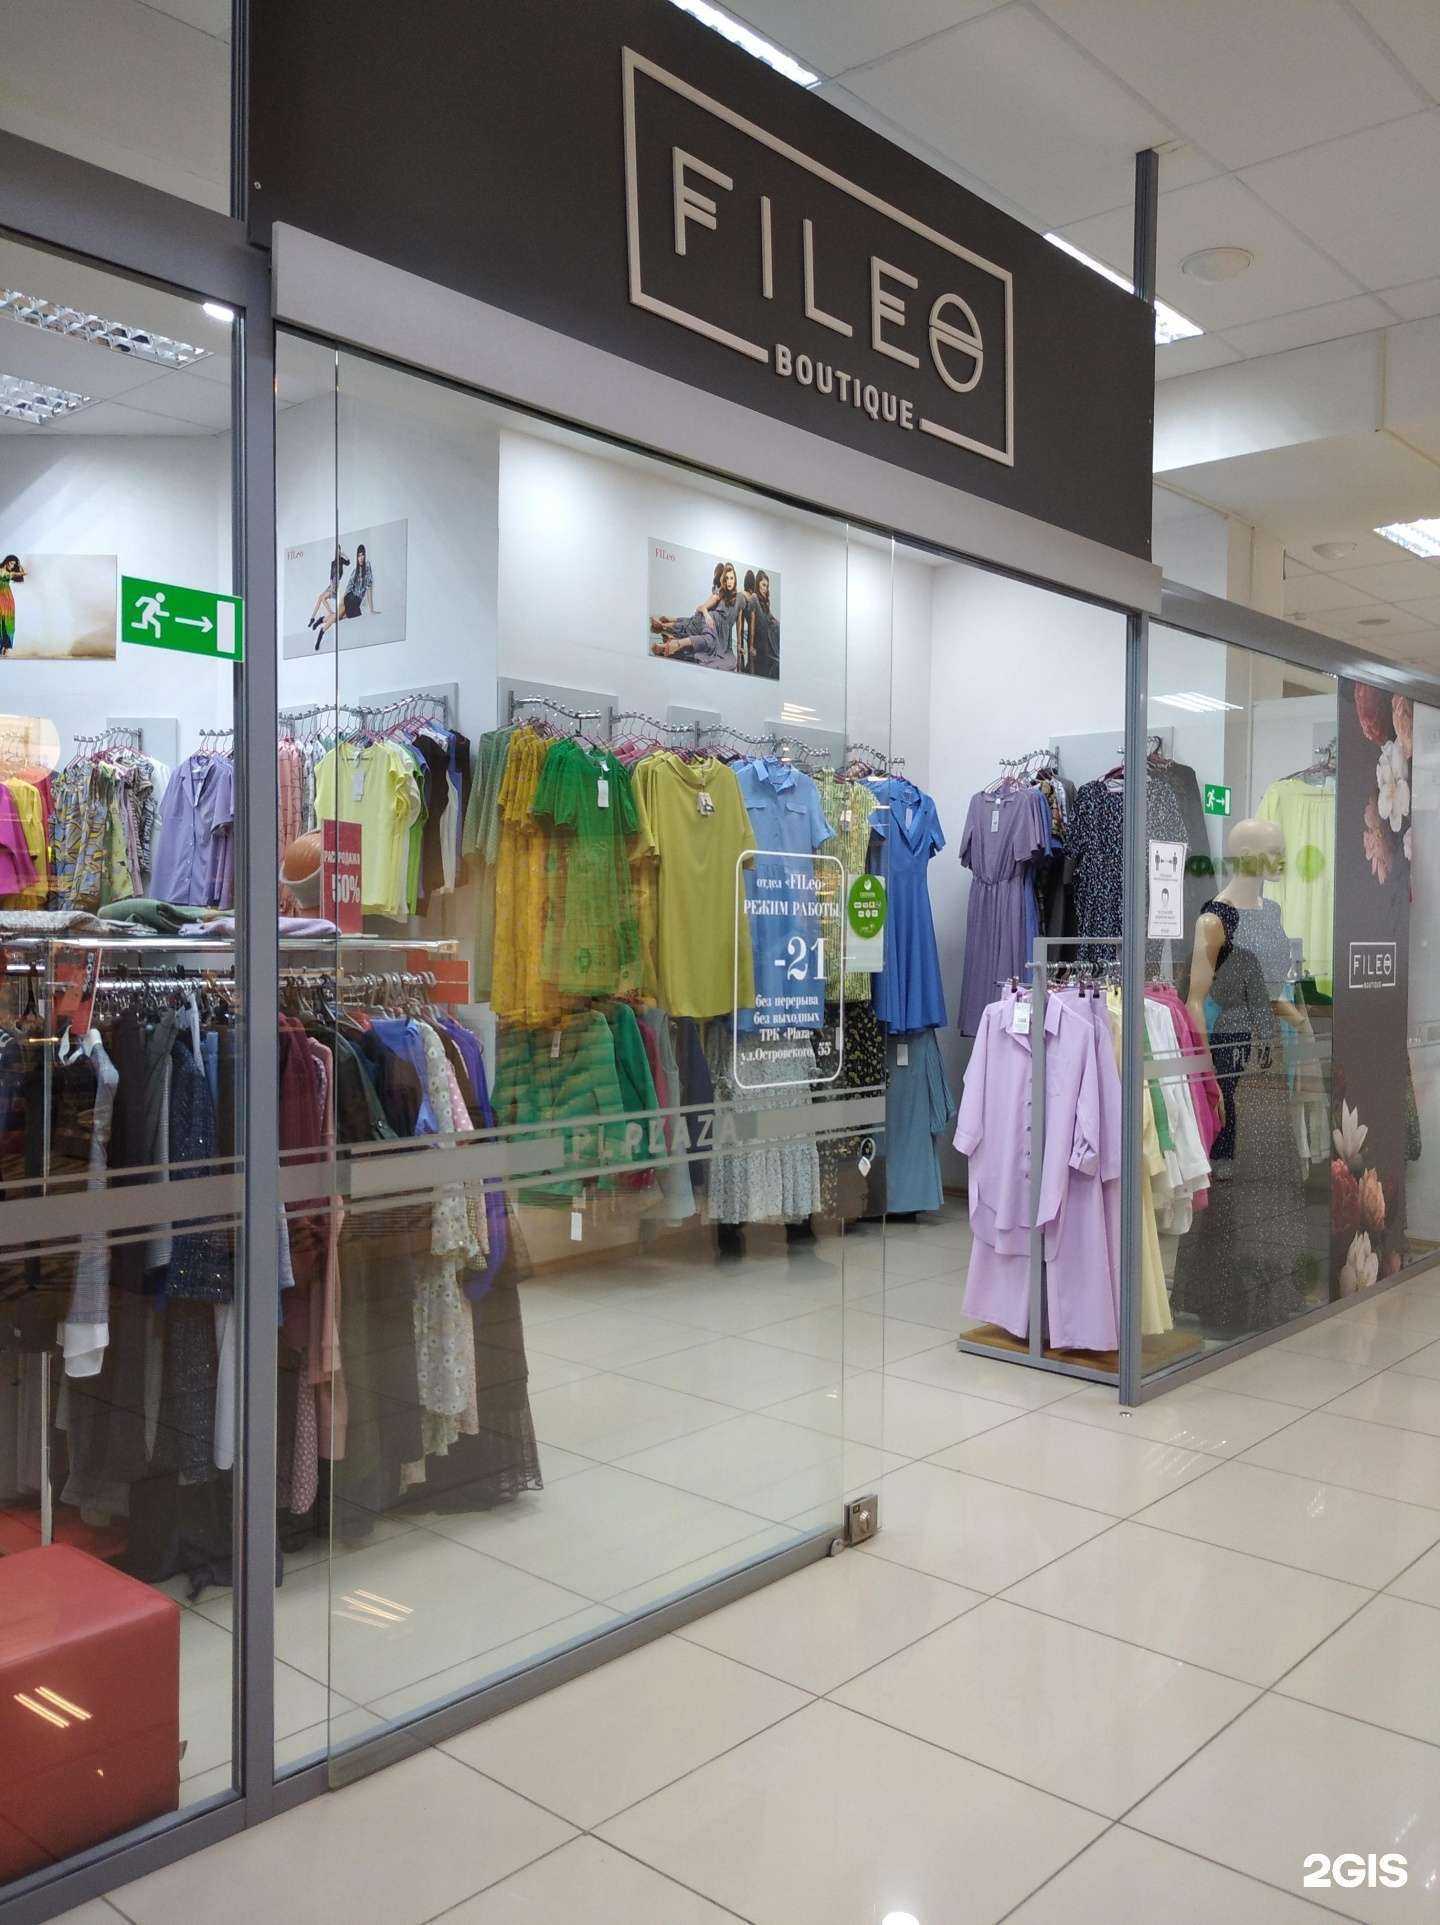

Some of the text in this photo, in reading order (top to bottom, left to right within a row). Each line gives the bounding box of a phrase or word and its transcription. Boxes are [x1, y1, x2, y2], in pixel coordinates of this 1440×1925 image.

[672, 146, 984, 392] FILEO
[775, 343, 914, 430] BOUTIQUE
[756, 878, 782, 890] отдел
[744, 899, 788, 916] РЕЖИМ
[792, 901, 839, 917] РАБОТЫ
[755, 994, 819, 1009] без перерыва
[753, 1012, 820, 1025] без выходных
[760, 1028, 780, 1042] ТРК
